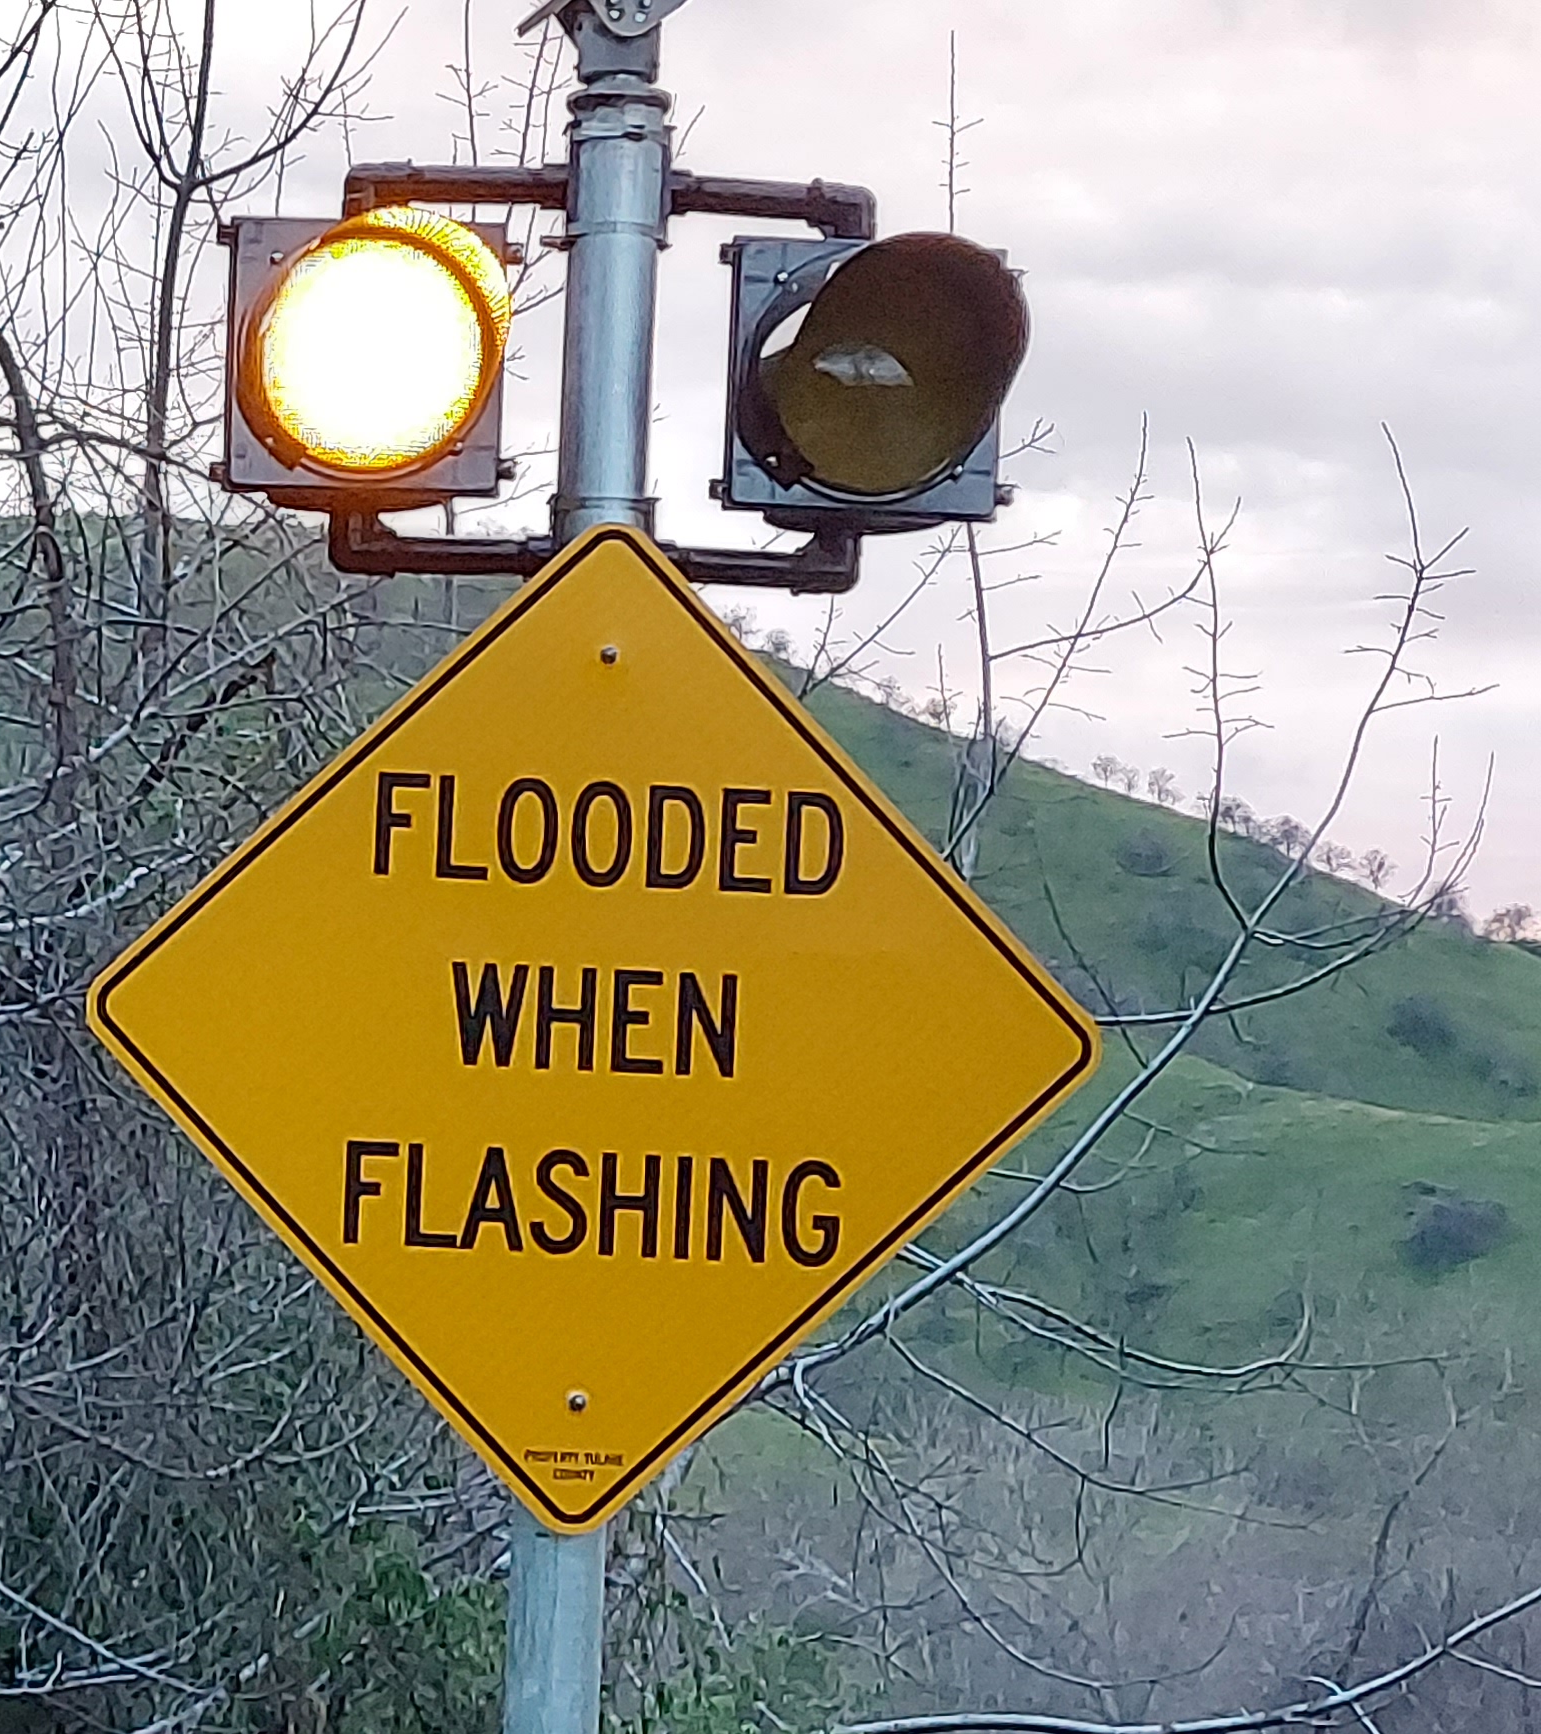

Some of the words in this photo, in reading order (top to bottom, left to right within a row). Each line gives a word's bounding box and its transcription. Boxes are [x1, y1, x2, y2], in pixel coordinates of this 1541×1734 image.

[372, 770, 845, 898] FLOODED
[450, 960, 740, 1079] WHEN
[341, 1139, 843, 1269] FLASHING
